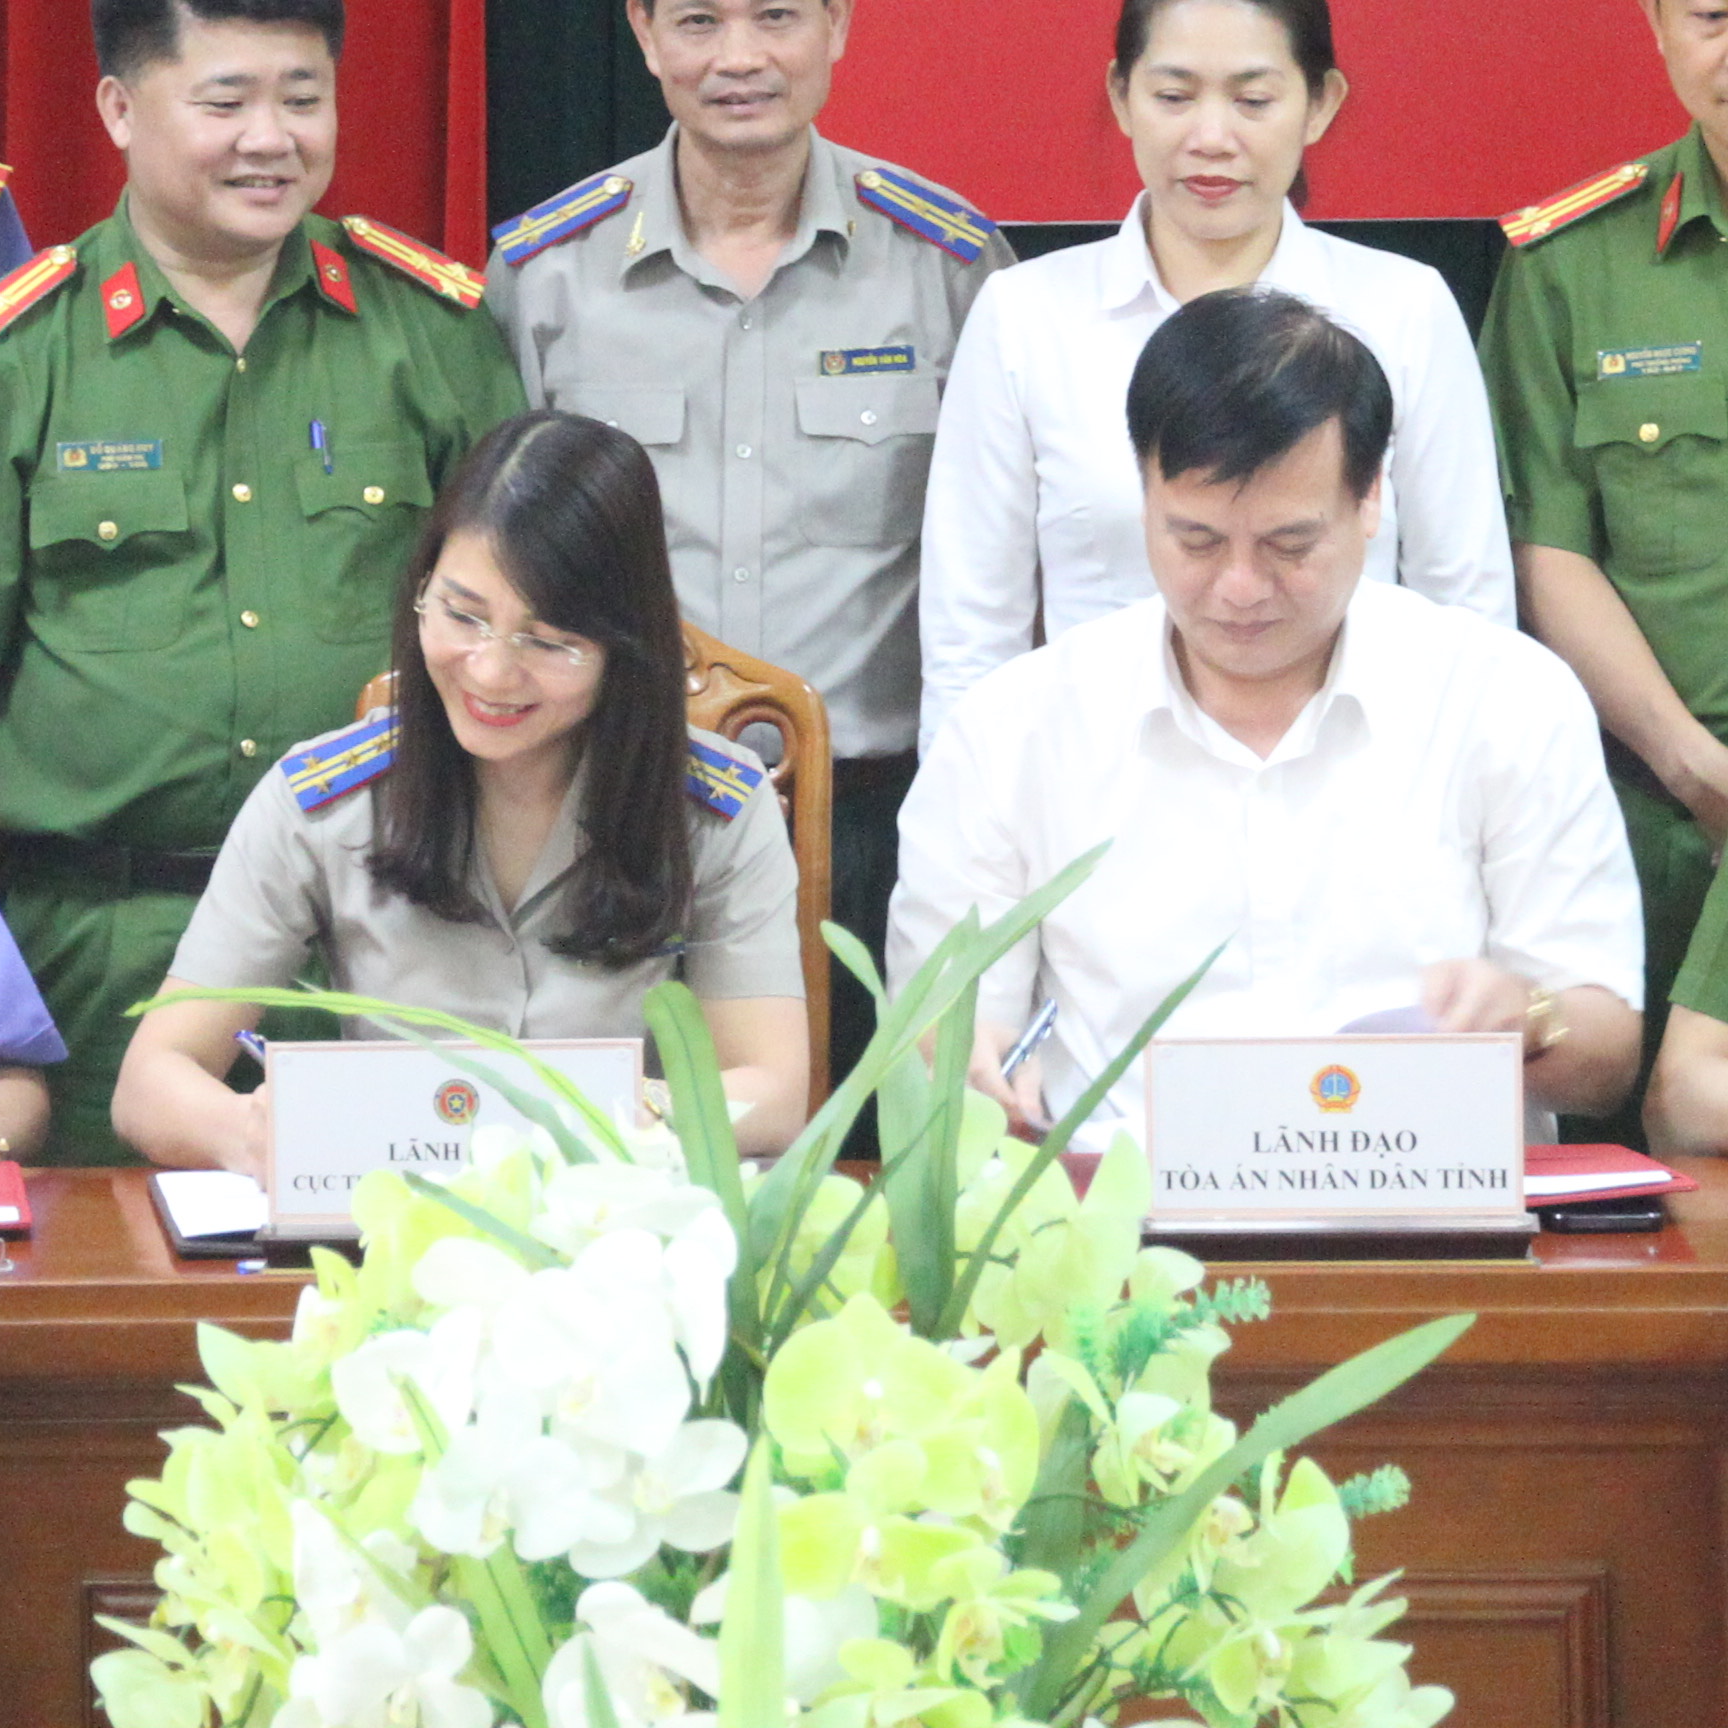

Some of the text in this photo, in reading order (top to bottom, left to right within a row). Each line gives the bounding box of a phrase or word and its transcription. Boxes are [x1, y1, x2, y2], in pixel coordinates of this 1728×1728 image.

[389, 1138, 460, 1162] LÃNH
[1252, 1126, 1418, 1158] LÃNH ĐẠO
[293, 1174, 337, 1194] CỤC
[1160, 1163, 1508, 1190] TÒA ÁN NHÂN DÂN TỈNH
